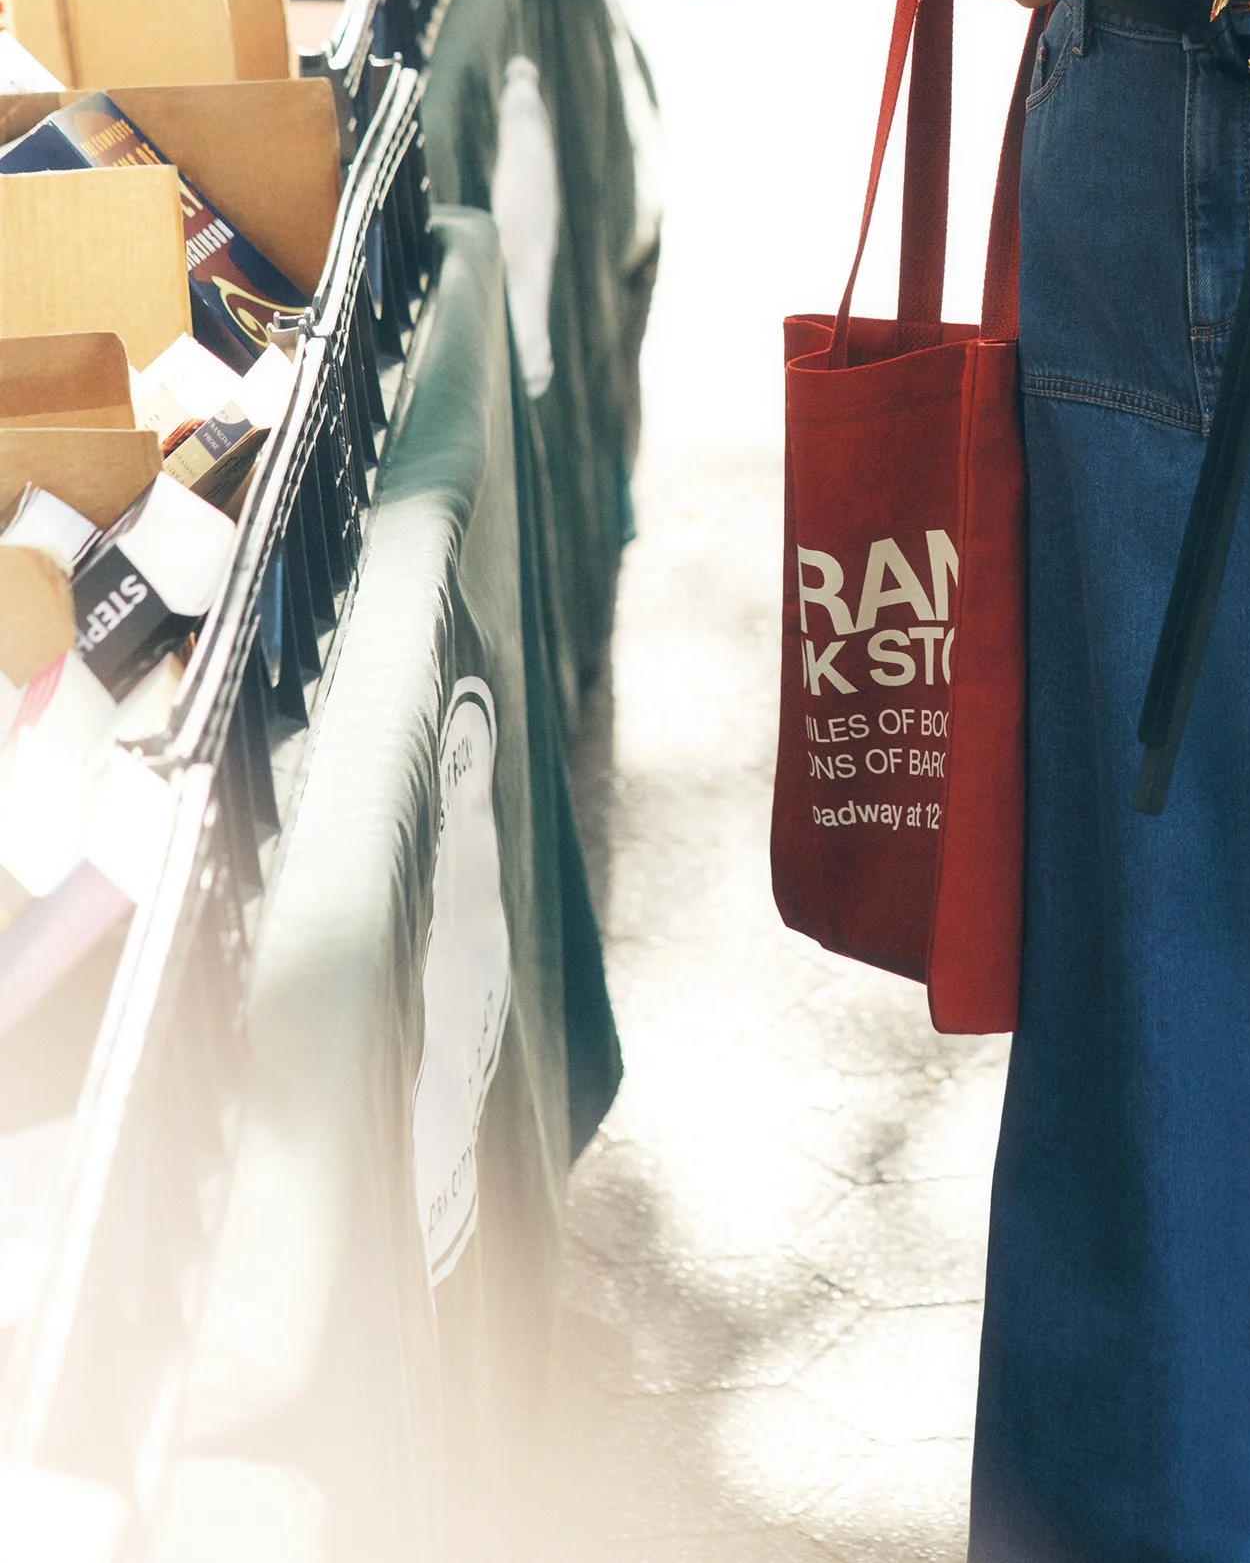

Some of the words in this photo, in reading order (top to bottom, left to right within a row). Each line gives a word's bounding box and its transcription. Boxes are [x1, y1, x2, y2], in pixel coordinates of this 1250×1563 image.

[207, 419, 232, 448] FRANCINE
[802, 640, 858, 696] K
[806, 714, 870, 742] ILES
[879, 709, 915, 735] OF
[865, 748, 903, 774] OF
[906, 802, 922, 827] at
[926, 802, 942, 829] 12
